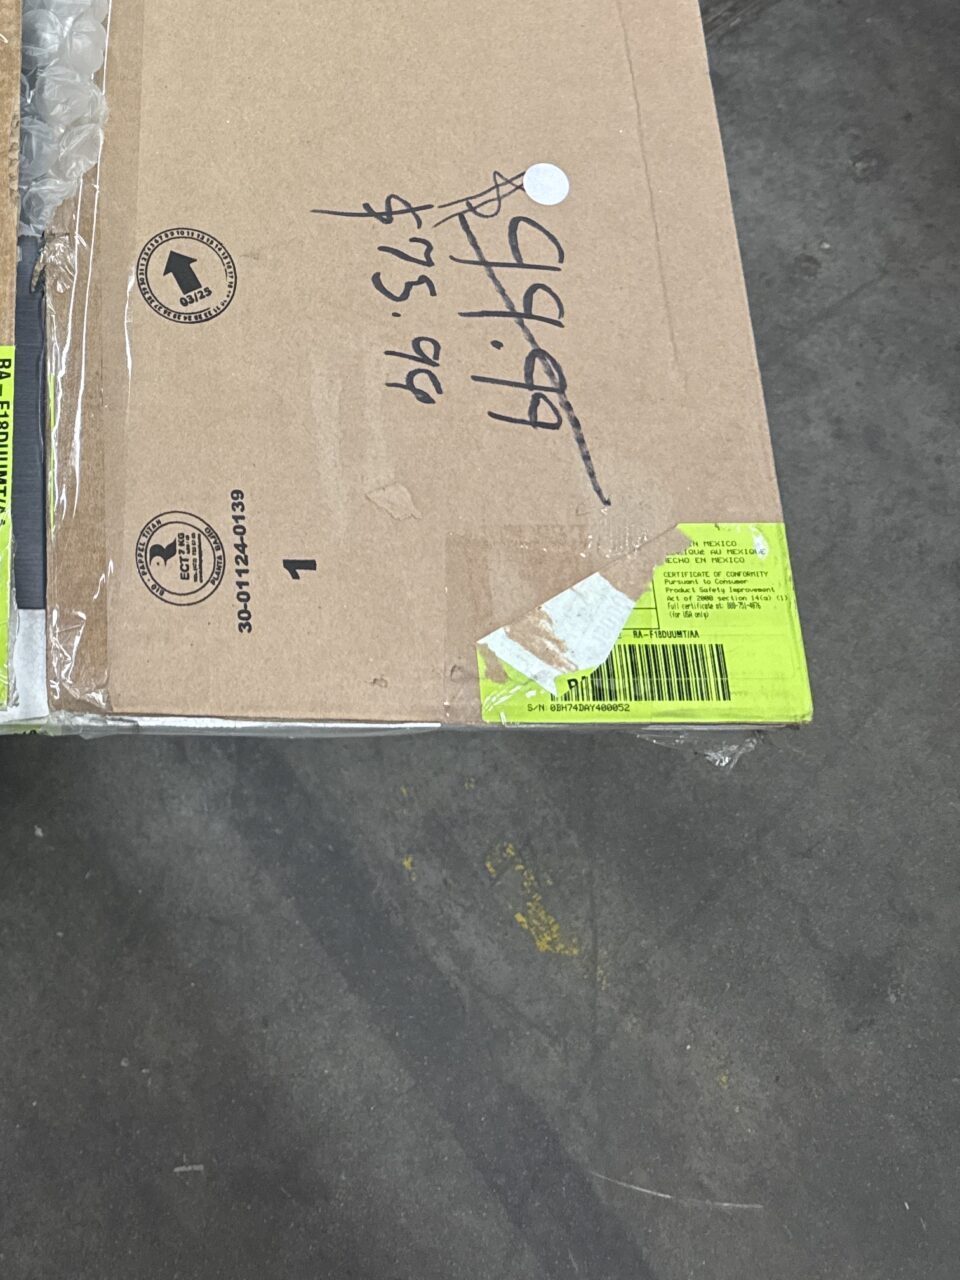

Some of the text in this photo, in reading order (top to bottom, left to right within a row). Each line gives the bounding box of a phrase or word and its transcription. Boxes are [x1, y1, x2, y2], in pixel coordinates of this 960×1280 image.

[179, 286, 212, 307] 03/25
[178, 533, 184, 547] KG
[138, 519, 165, 596] BIO PAPPEL TITAN
[179, 556, 190, 580] ECT
[230, 489, 252, 633] 30-01124-0139
[210, 555, 222, 586] PLANTA
[283, 560, 317, 579] 1
[527, 704, 545, 712] S/N
